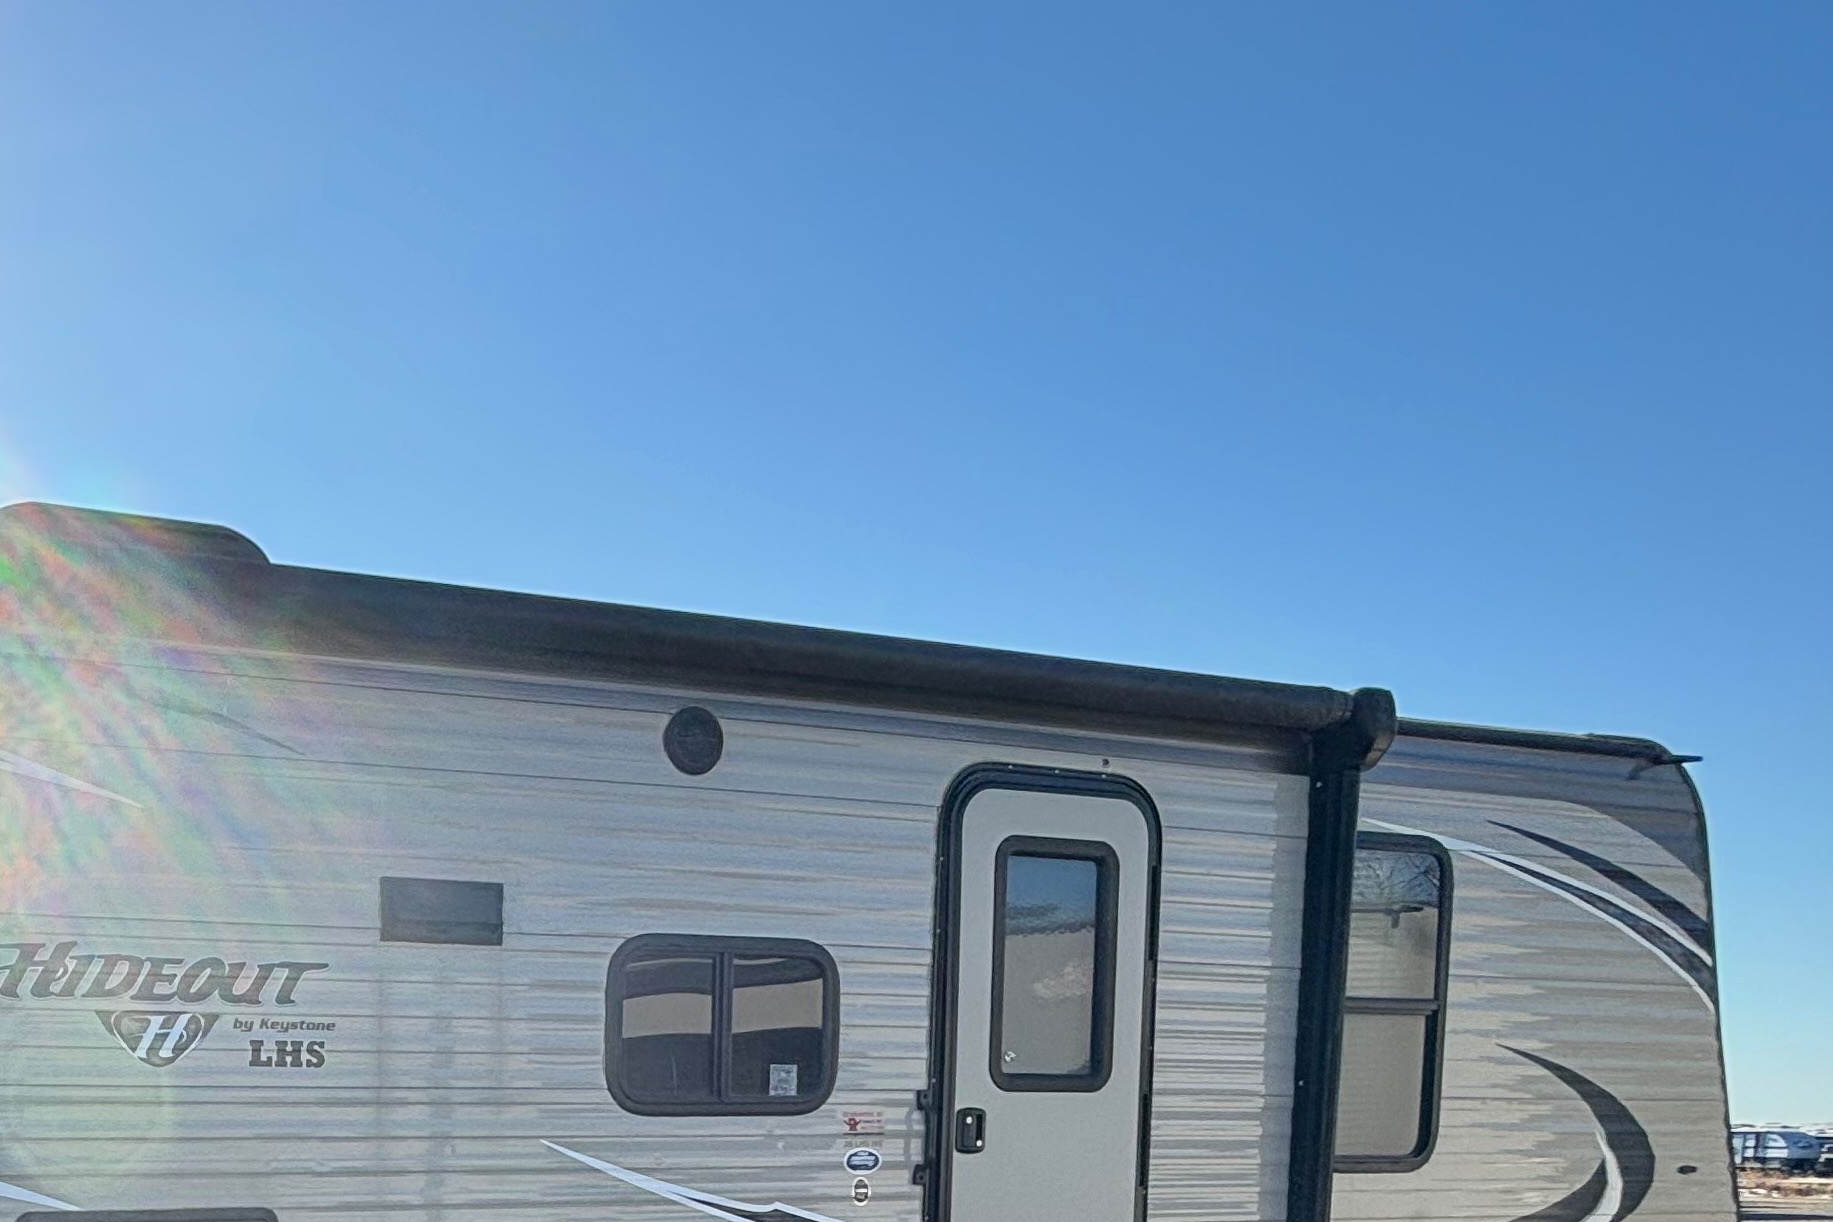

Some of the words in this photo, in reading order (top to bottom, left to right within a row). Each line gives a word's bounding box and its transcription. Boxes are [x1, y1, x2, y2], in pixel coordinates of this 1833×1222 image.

[233, 1018, 254, 1032] by
[259, 1018, 336, 1033] Keystone
[249, 1040, 325, 1068] LHS
